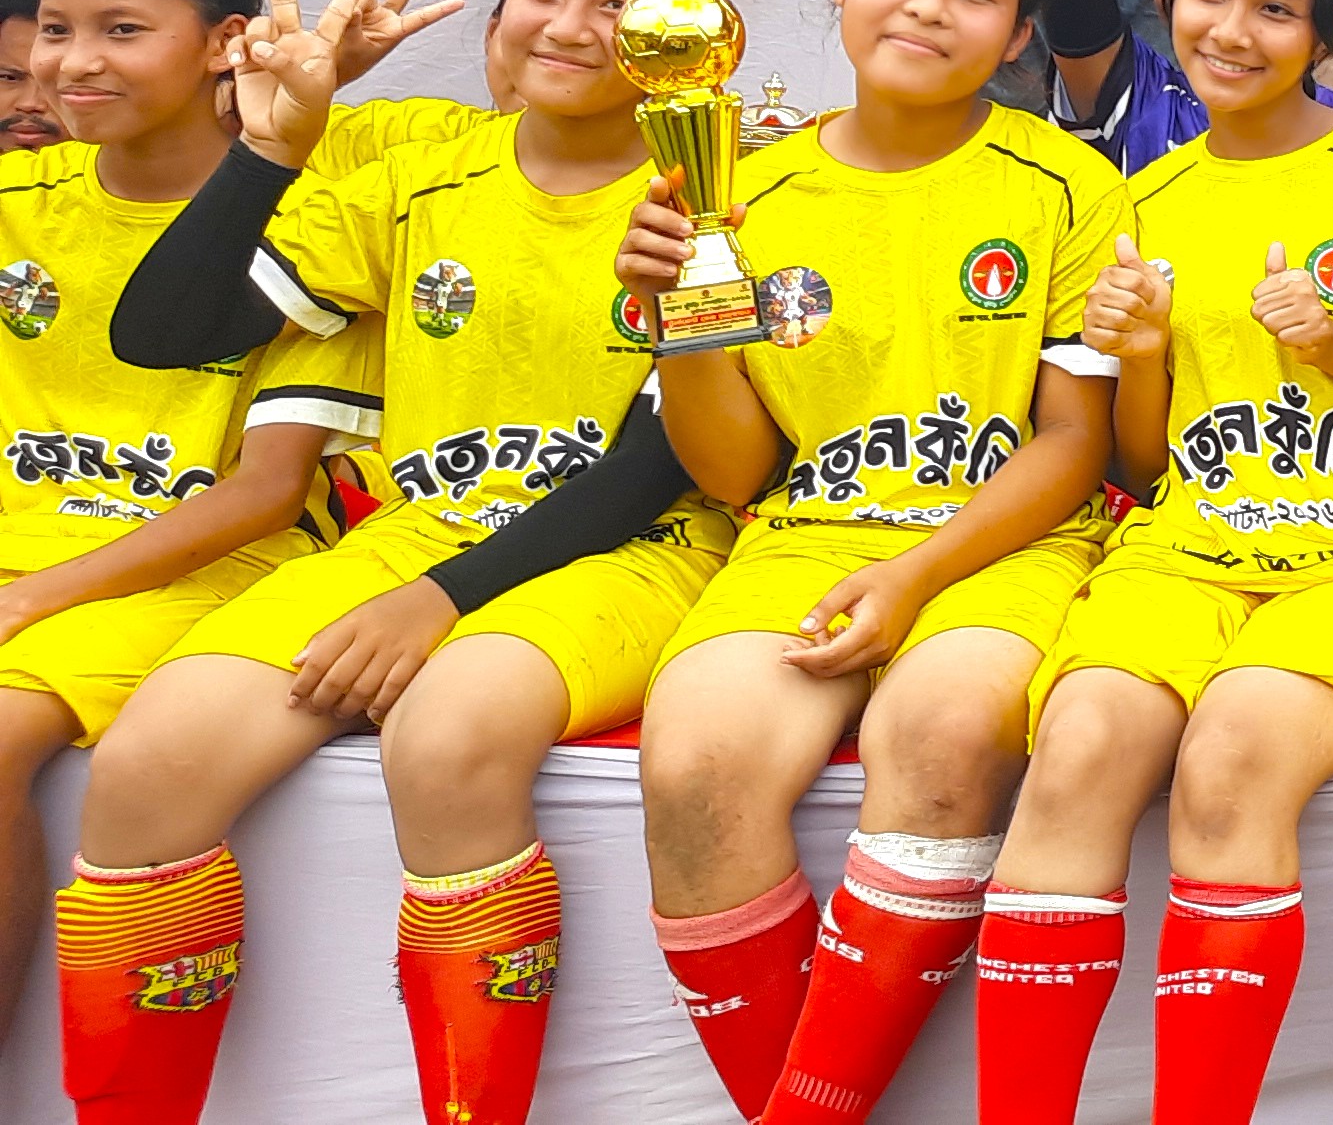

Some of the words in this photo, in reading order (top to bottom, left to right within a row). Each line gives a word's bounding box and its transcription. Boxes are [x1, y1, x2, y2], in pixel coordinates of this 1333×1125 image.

[980, 968, 1074, 986] UNITED
[1156, 968, 1266, 988] CHESTER
[1155, 982, 1214, 997] NITED
